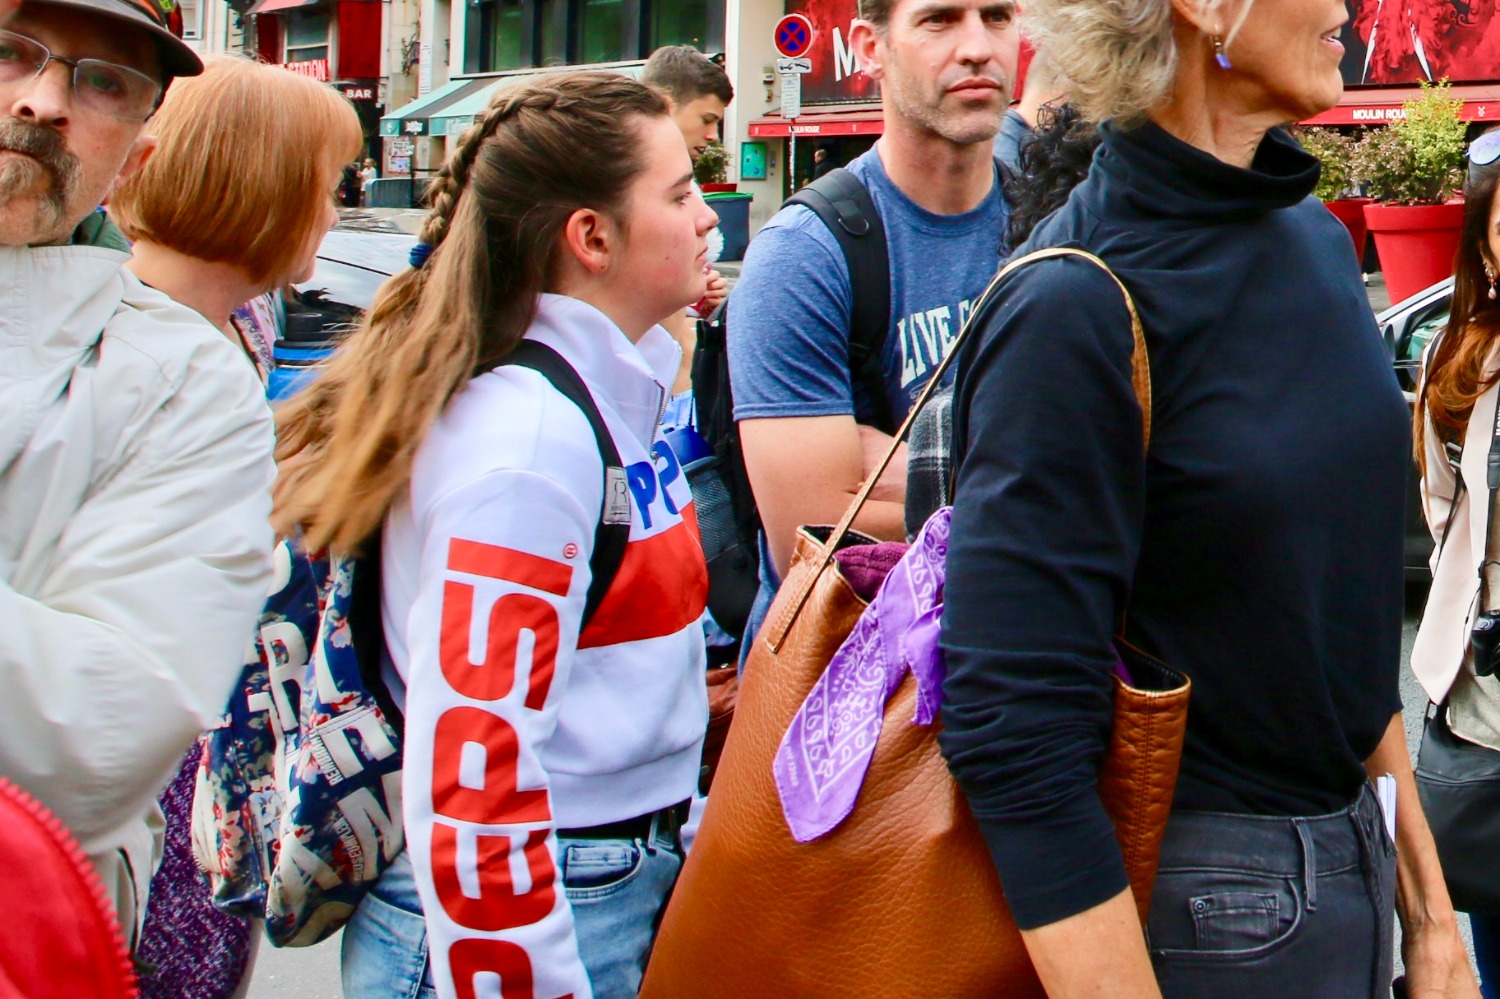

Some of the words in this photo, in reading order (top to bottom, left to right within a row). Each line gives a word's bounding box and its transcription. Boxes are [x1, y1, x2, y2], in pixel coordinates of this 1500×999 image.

[346, 88, 372, 99] BAR
[1353, 109, 1384, 120] MOULIN
[897, 305, 958, 389] LIVE
[430, 536, 575, 999] PEPSI
